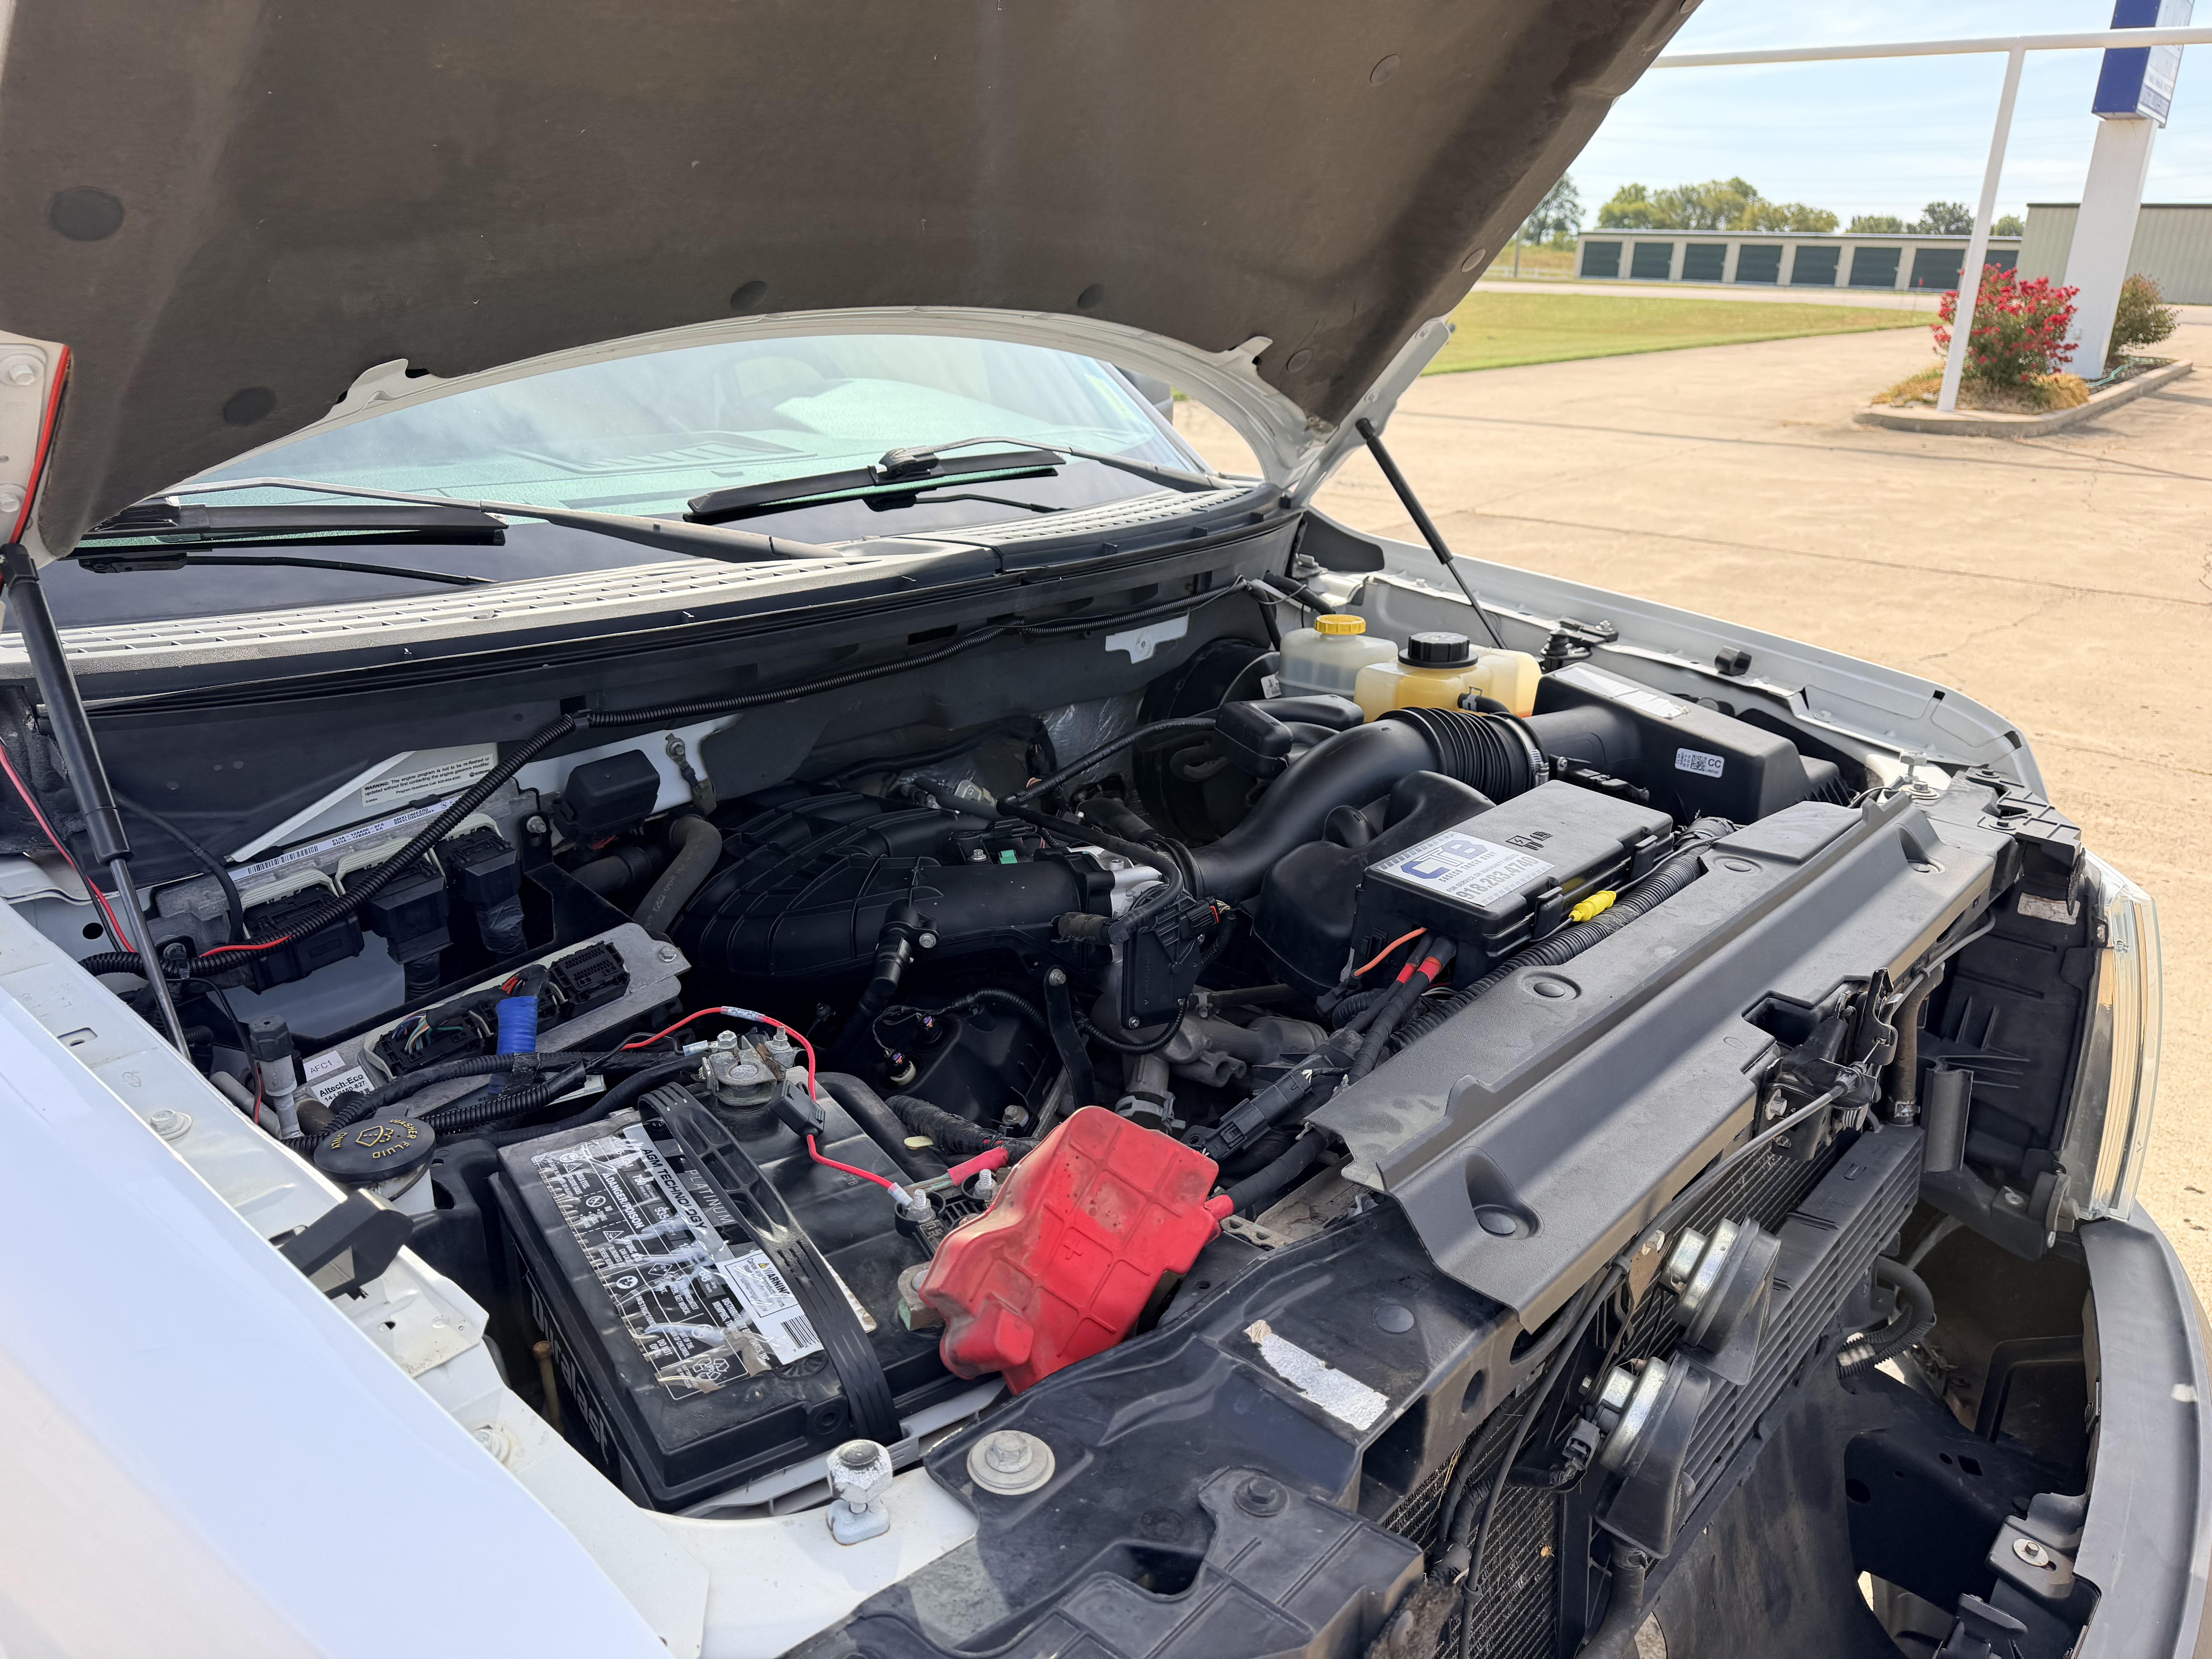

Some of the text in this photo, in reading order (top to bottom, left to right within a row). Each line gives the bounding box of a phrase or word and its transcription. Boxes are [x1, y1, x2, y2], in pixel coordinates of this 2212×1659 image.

[1708, 759, 1721, 768] CC
[364, 781, 389, 790] WARNING:
[365, 788, 383, 796] updated
[409, 776, 430, 785] contacting
[1400, 840, 1488, 879] CTB
[1460, 859, 1480, 871] TRUCK
[1480, 851, 1497, 860] BODY
[1456, 856, 1539, 899] 918.283.4740
[1458, 875, 1476, 887] SERVICE
[1479, 860, 1503, 875] WARRANTY
[311, 1060, 332, 1074] AFC1
[320, 1074, 364, 1097] Altech-Eco
[331, 1119, 418, 1159] WASHER FLUID ONLY
[641, 1147, 708, 1231] AGM TECHNOLOGY
[684, 1168, 735, 1225] PLATINUM
[604, 1176, 645, 1229] DANGER/POISON
[653, 1206, 670, 1219] 935
[607, 1246, 623, 1263] BLINDNESS
[746, 1258, 759, 1270] Cancer
[759, 1276, 779, 1297] Reproducti
[673, 1295, 684, 1303] GET
[677, 1301, 692, 1315] MEDICAL
[680, 1288, 701, 1310] IMMEDIATELY
[709, 1300, 731, 1322] MEMPHIS,
[721, 1297, 745, 1324] DISTRIBUTE
[656, 1338, 673, 1356] DO NOT
[706, 1364, 716, 1373] Pb
